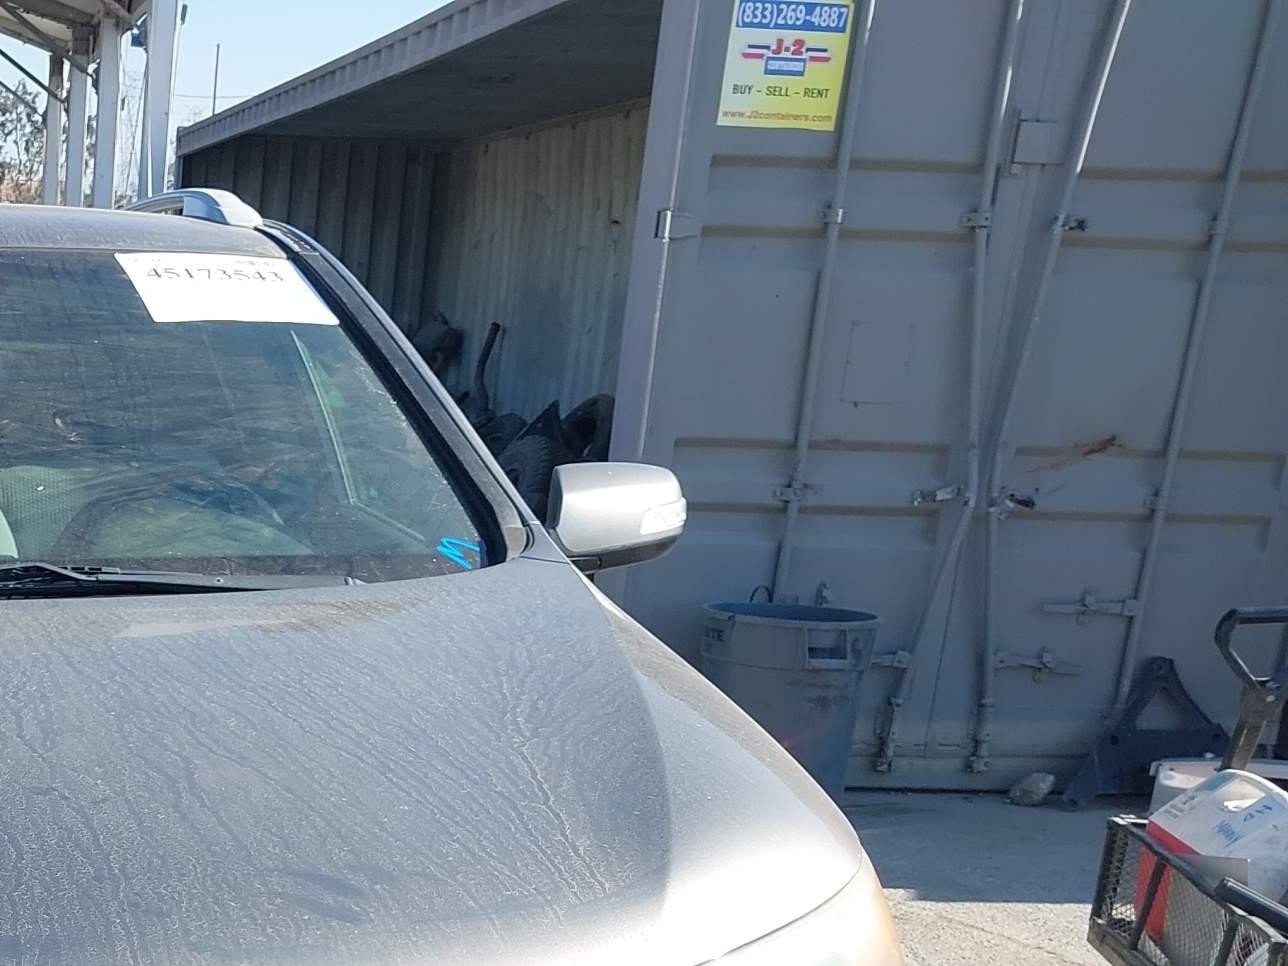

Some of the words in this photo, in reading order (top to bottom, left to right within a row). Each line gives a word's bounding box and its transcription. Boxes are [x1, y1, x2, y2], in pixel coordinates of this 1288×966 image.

[738, 2, 849, 28] (833)269-4887
[771, 38, 806, 56] J-2
[732, 84, 754, 95] BUY
[766, 86, 791, 97] SELL
[803, 88, 831, 99] RENT
[147, 267, 285, 282] 45173543
